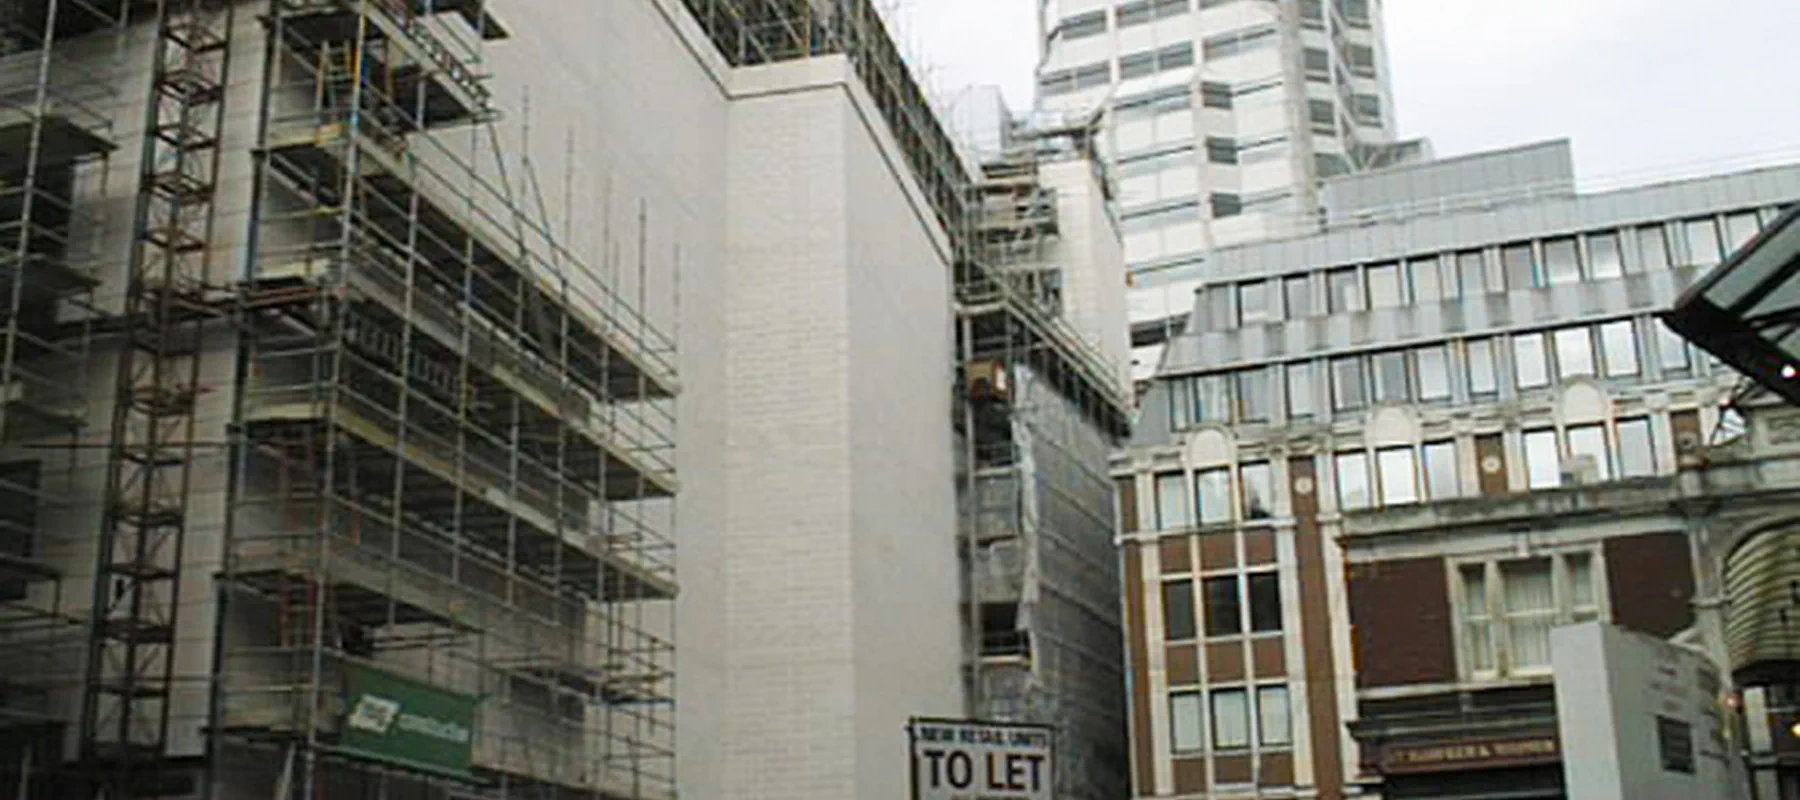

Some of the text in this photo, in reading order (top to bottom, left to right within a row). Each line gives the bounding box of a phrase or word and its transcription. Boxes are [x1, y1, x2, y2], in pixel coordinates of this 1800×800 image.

[920, 726, 954, 742] NEW
[924, 750, 1044, 791] TO LET
